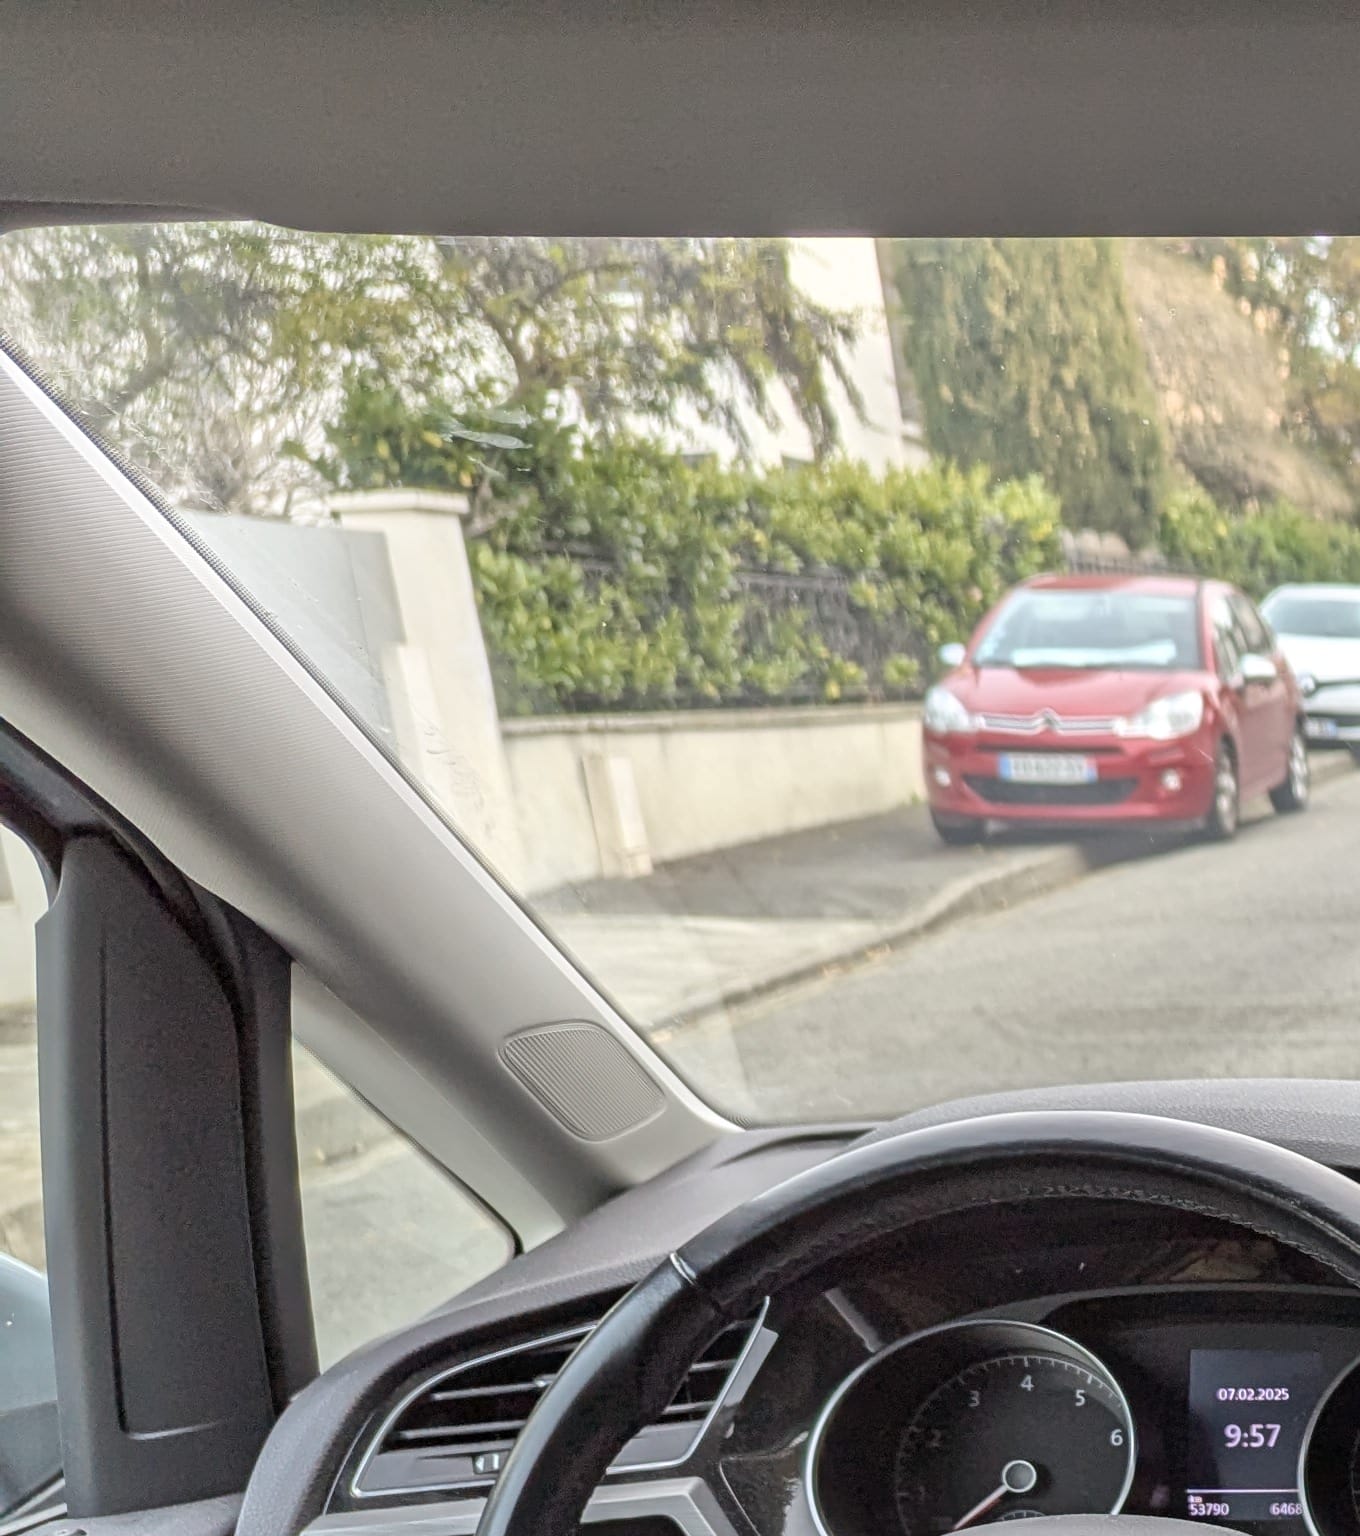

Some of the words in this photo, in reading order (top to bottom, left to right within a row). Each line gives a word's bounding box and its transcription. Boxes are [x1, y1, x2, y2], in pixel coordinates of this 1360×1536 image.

[1020, 1375, 1034, 1391] 4
[969, 1390, 980, 1407] 3
[1075, 1389, 1086, 1406] 5
[1218, 1388, 1290, 1401] 07.02.2025
[1111, 1429, 1123, 1446] 6
[1224, 1423, 1281, 1448] 9:57
[1189, 1503, 1230, 1516] 53790
